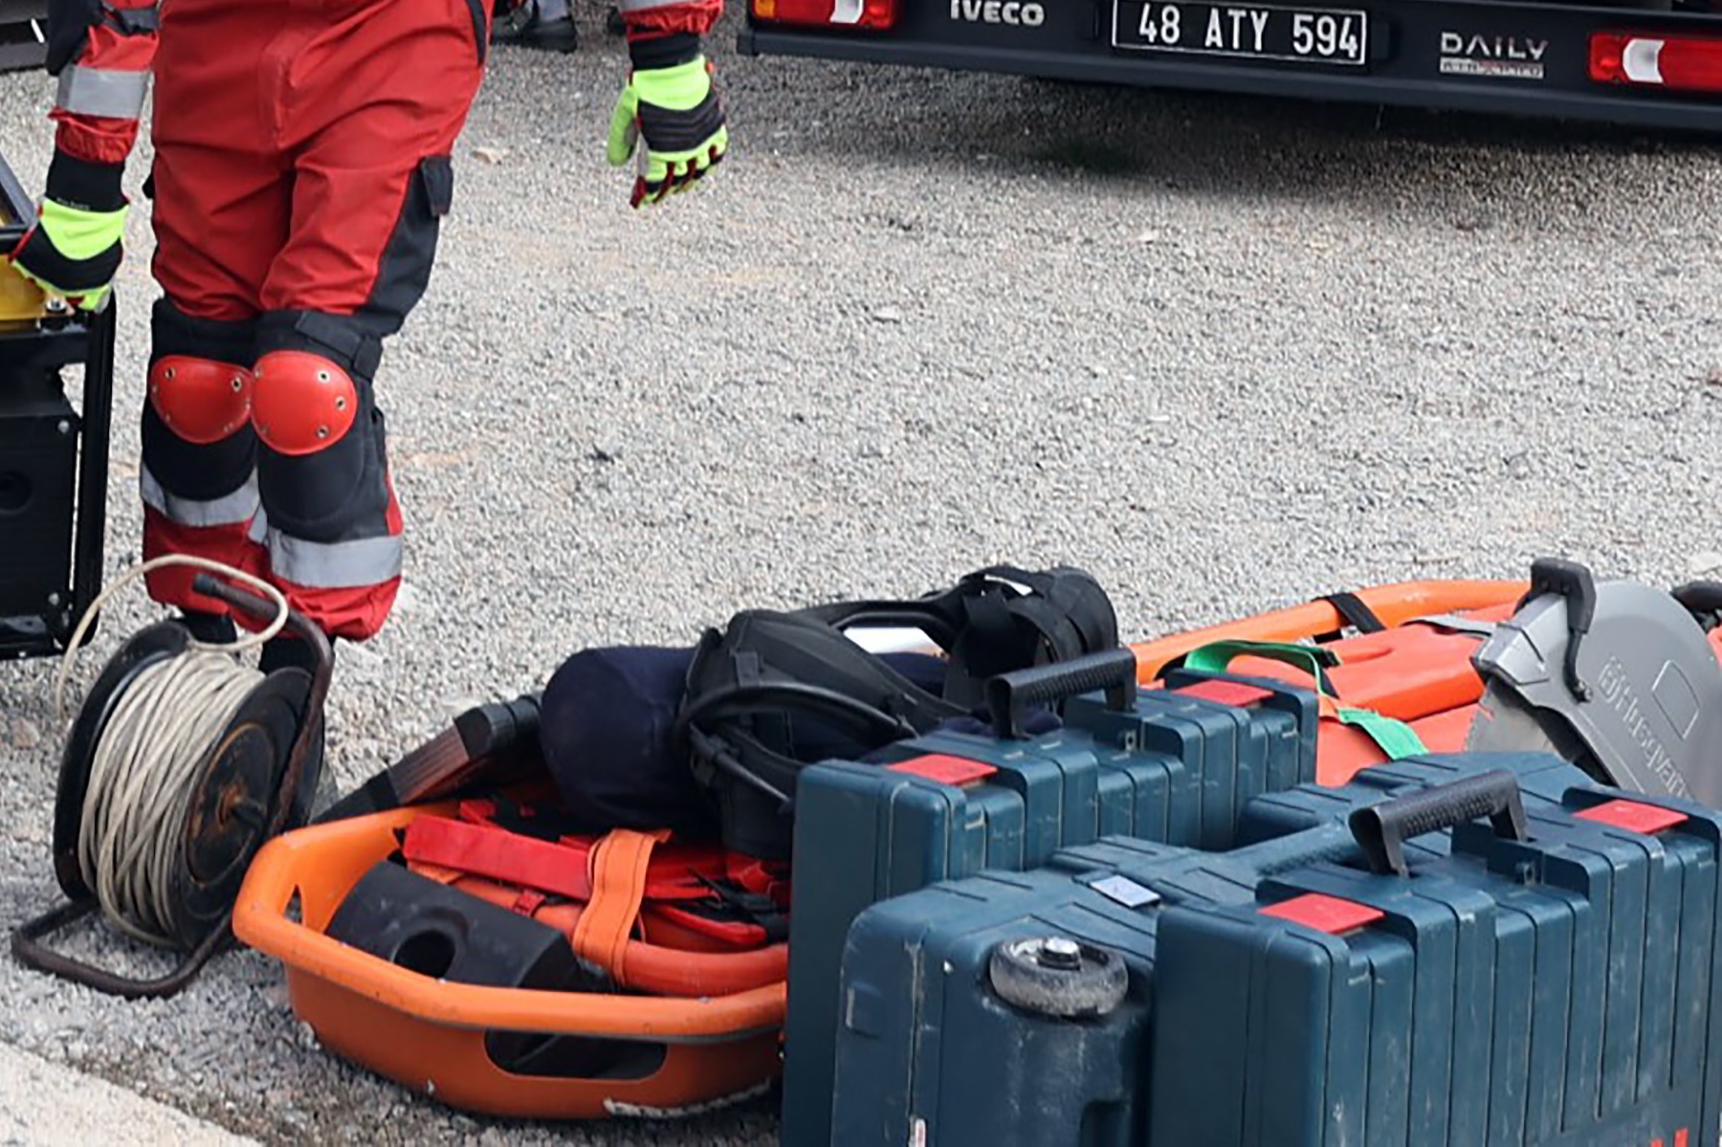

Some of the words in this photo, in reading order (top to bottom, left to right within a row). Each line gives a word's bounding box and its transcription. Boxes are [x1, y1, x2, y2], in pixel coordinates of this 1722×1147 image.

[1139, 2, 1180, 44] 48
[1204, 7, 1269, 51] ATY
[1292, 13, 1358, 59] 594
[1441, 32, 1548, 60] DAILY
